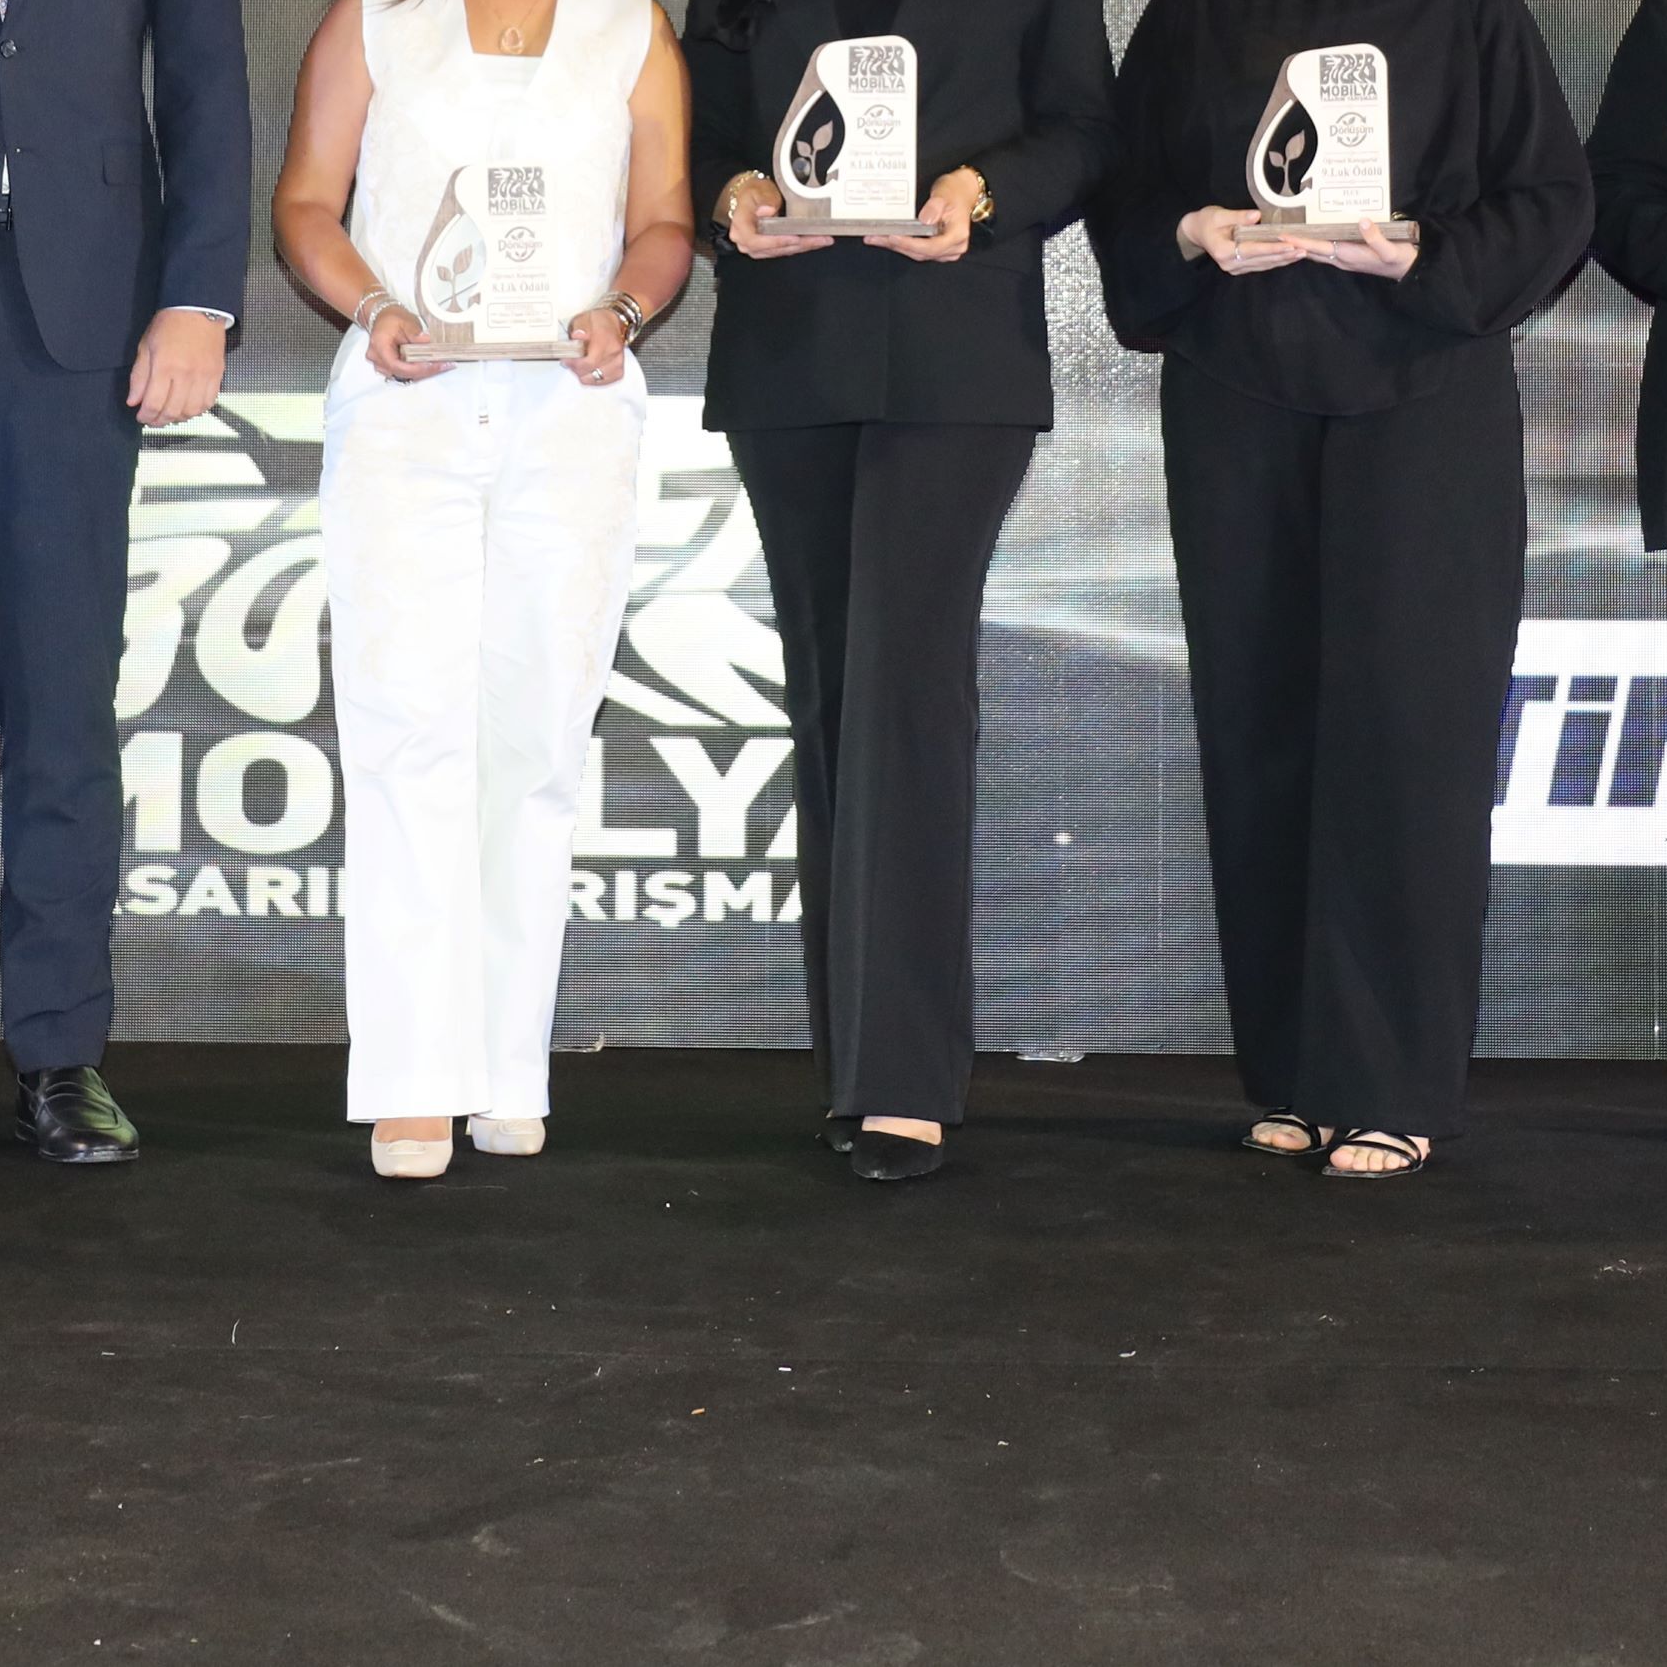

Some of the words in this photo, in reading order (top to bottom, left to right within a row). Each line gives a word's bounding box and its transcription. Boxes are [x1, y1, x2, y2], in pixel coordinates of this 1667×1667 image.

[1320, 85, 1377, 97] MOBİLYA
[1330, 124, 1374, 137] Dönüşüm
[1352, 165, 1382, 177] Ödülü
[489, 198, 546, 211] MOBİLYA
